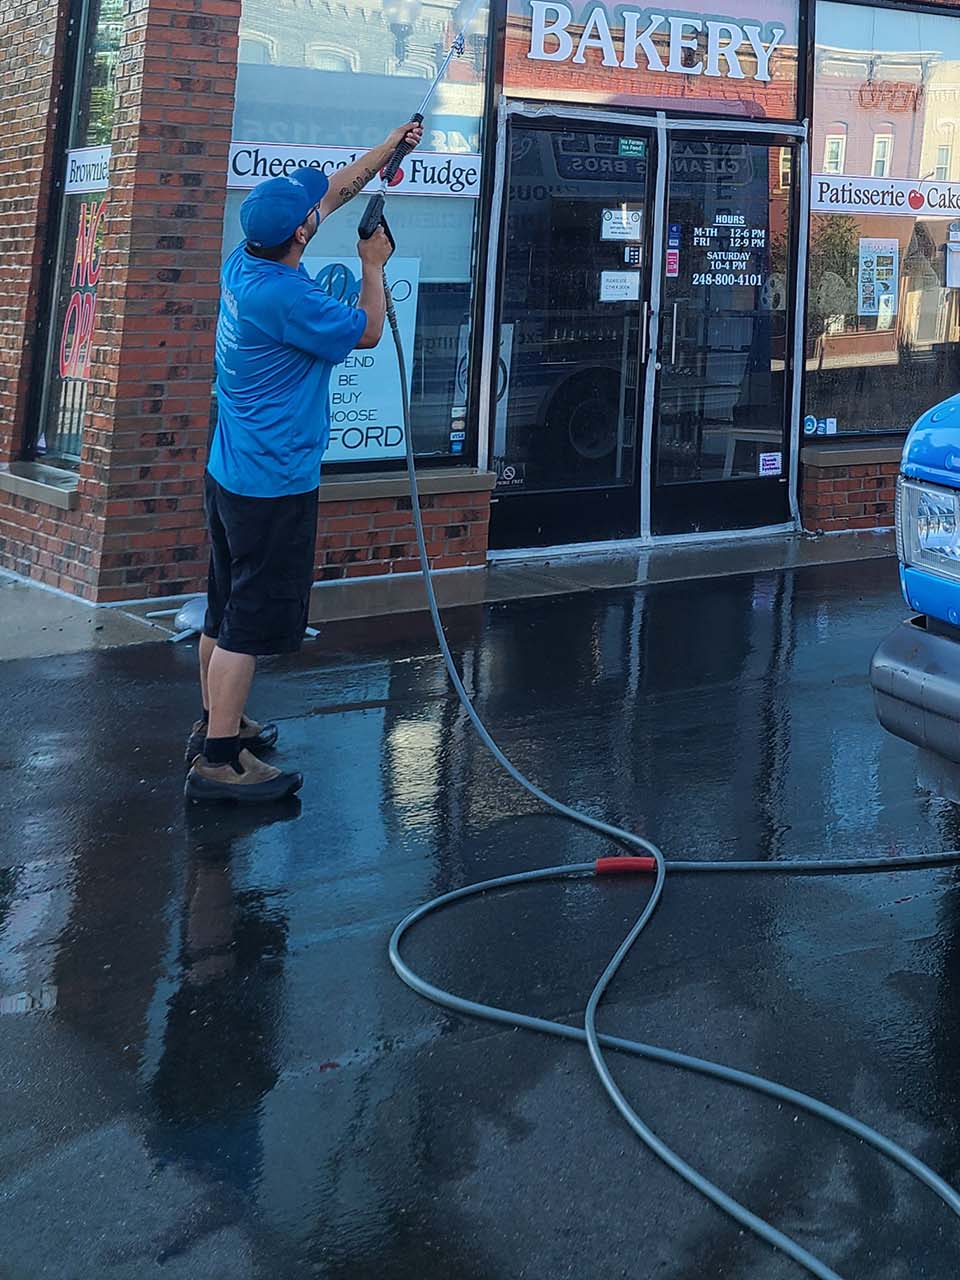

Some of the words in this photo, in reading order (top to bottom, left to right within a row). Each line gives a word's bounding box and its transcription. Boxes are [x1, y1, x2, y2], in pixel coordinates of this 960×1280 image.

[527, 0, 785, 82] BAKERY
[410, 159, 477, 192] Fudge
[818, 181, 905, 206] Patisserie
[715, 214, 745, 224] HOURS
[693, 227, 718, 237] M-TH
[730, 228, 749, 238] 12-6
[751, 229, 765, 238] PM
[693, 237, 710, 246] FRI
[730, 238, 749, 247] 12-9
[751, 239, 765, 248] PM
[706, 251, 751, 261] SATURDAY
[710, 261, 730, 270] 10-4
[732, 261, 746, 270] PM
[692, 273, 762, 286] 248-800-4101
[338, 374, 358, 386] BE
[332, 391, 362, 404] BUY
